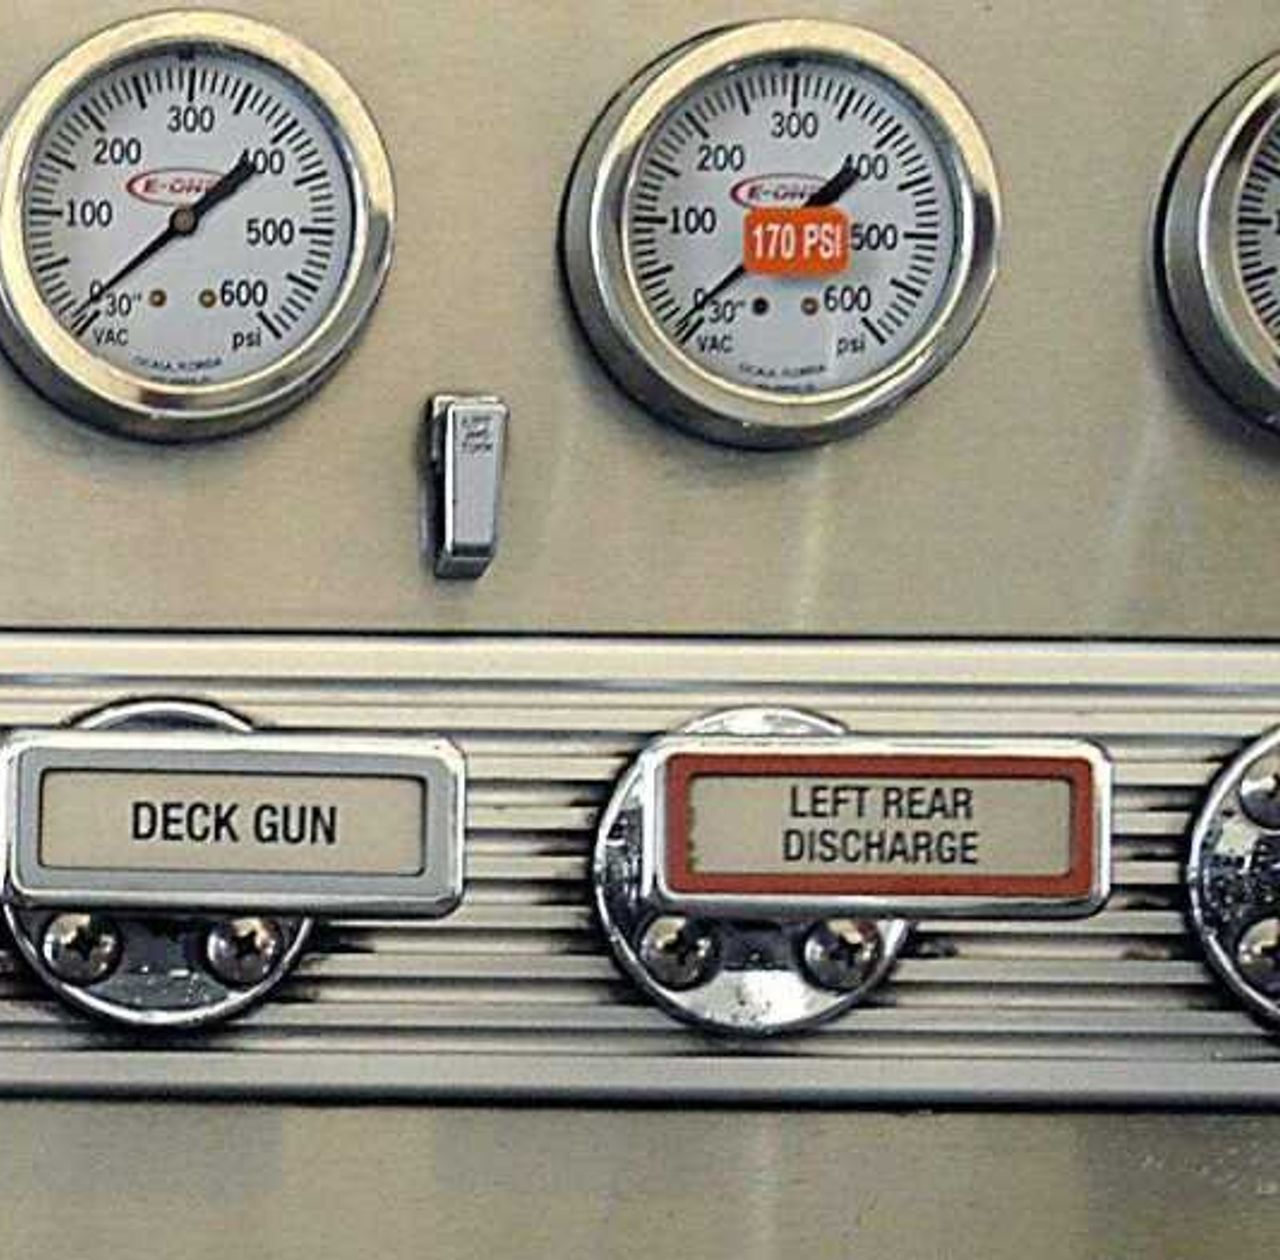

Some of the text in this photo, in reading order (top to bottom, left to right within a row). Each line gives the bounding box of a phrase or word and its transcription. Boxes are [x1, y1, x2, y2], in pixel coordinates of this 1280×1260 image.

[168, 106, 214, 132] 300
[772, 112, 818, 138] 300
[94, 139, 140, 164] 200
[697, 145, 744, 171] 200
[144, 177, 218, 194] E-ON
[748, 183, 818, 201] E-ON
[68, 201, 112, 226] 100
[671, 208, 716, 233] 100
[247, 219, 293, 245] 500
[752, 224, 840, 258] 170 PSI
[852, 225, 898, 250] 500
[220, 281, 268, 306] 600
[824, 287, 871, 312] 600
[94, 329, 128, 345] VAC
[232, 327, 261, 349] psi
[697, 336, 733, 352] VAC
[837, 336, 865, 356] psi
[790, 786, 973, 819] LEFT REAR
[132, 801, 337, 844] DECK GUN
[783, 830, 978, 865] DISCHARGE
